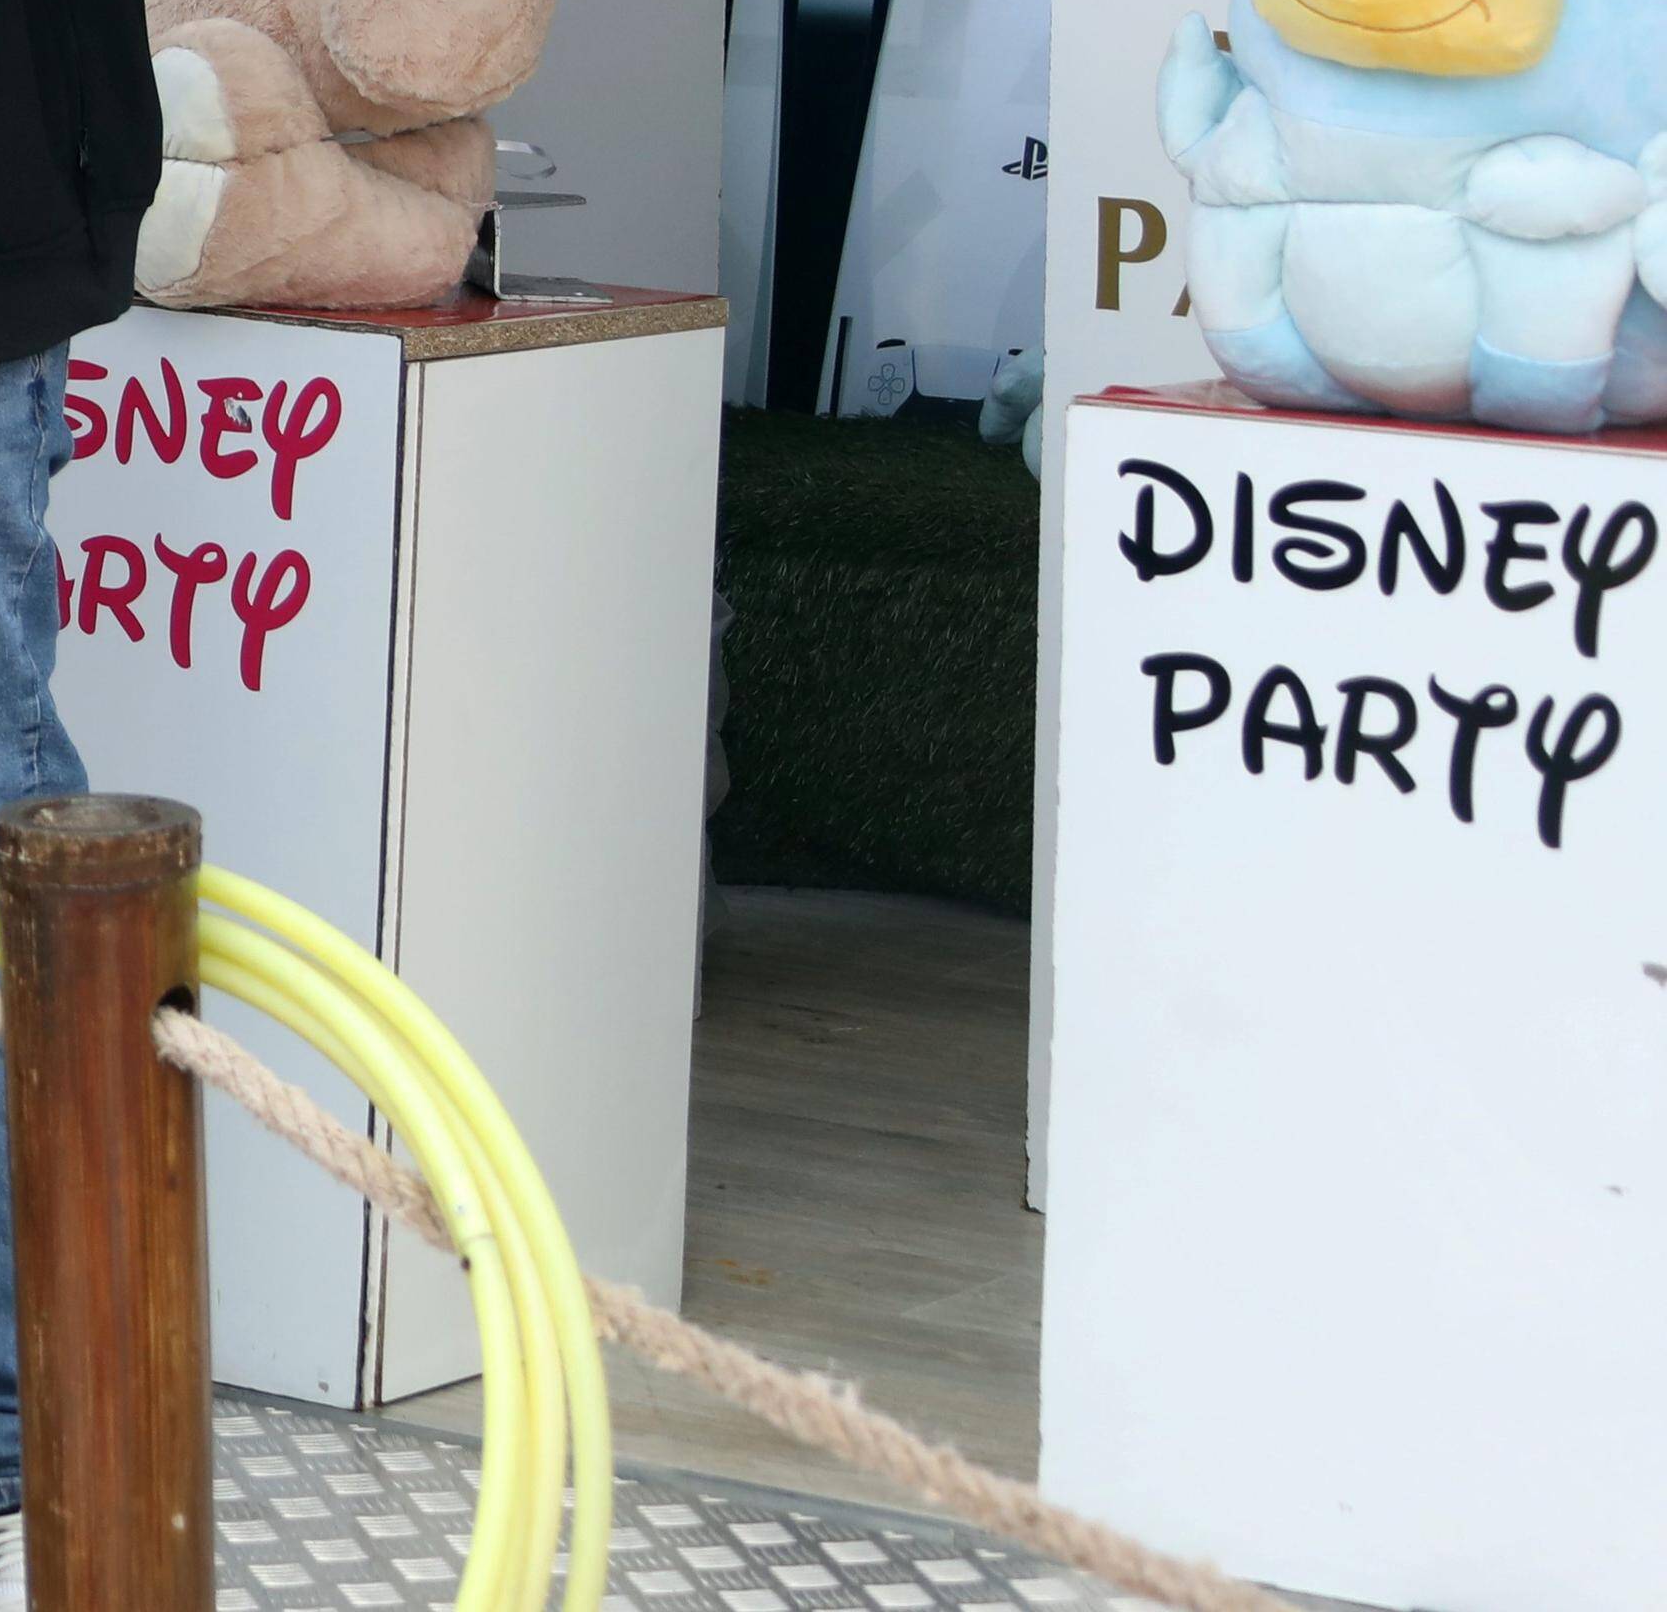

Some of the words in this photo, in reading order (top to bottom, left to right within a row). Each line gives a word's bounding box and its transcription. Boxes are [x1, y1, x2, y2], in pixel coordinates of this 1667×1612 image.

[64, 356, 342, 521] SNEY
[56, 533, 311, 691] RTY
[1117, 458, 1658, 659] DISNEY
[1140, 651, 1621, 850] PARTY
